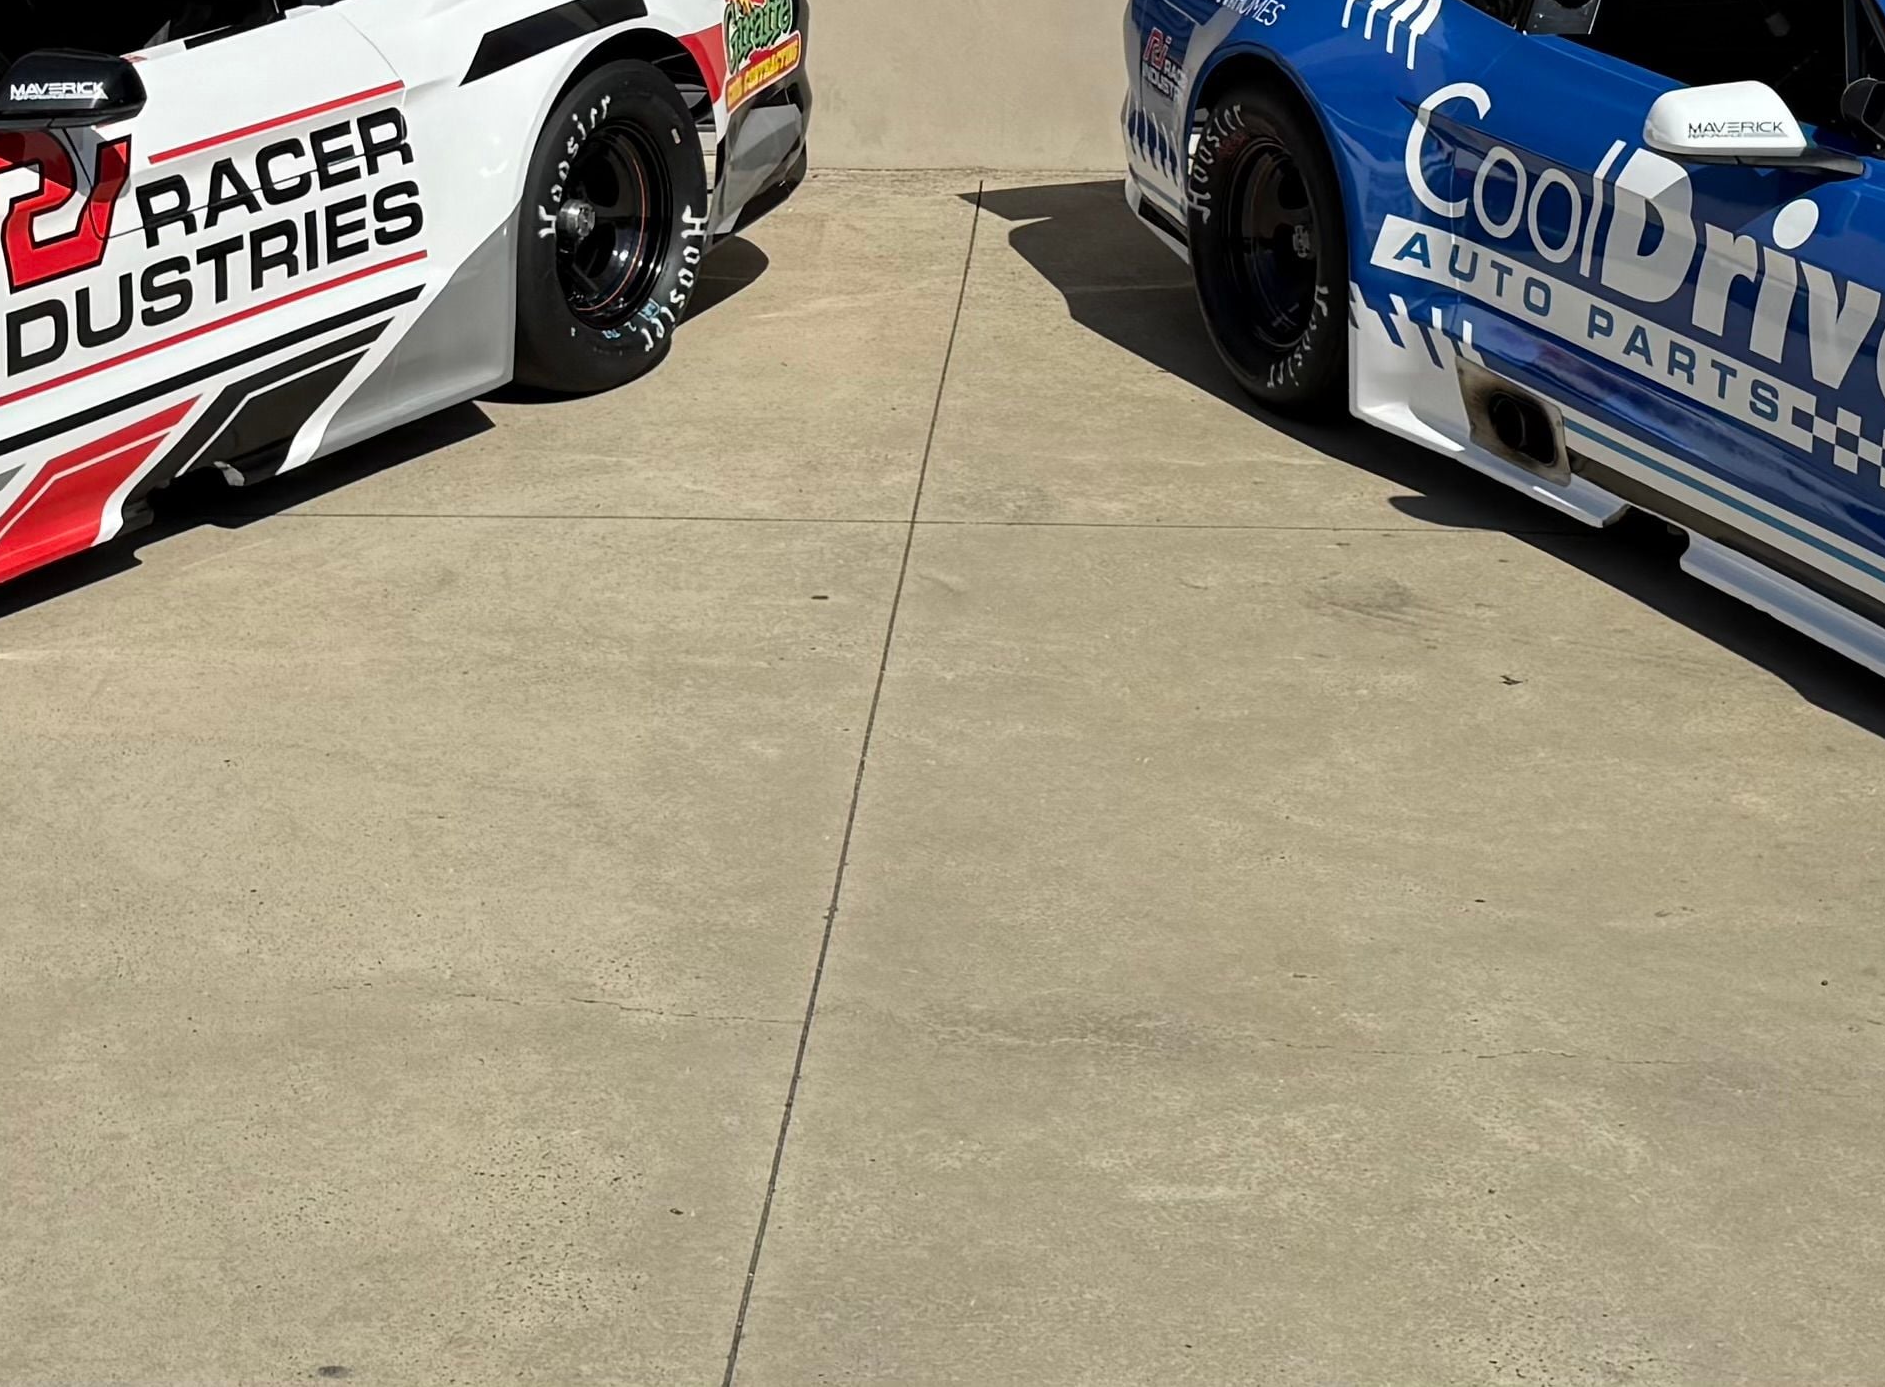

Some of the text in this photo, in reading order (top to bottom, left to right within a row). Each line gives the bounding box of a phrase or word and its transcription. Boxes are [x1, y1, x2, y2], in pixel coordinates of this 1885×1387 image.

[10, 81, 105, 96] MAVERICK
[1687, 120, 1784, 135] MAVERICK
[136, 107, 415, 251] RACER
[1188, 103, 1246, 225] Hoosier
[640, 203, 709, 353] Hoosier
[1392, 230, 1780, 423] AUTO PARTS
